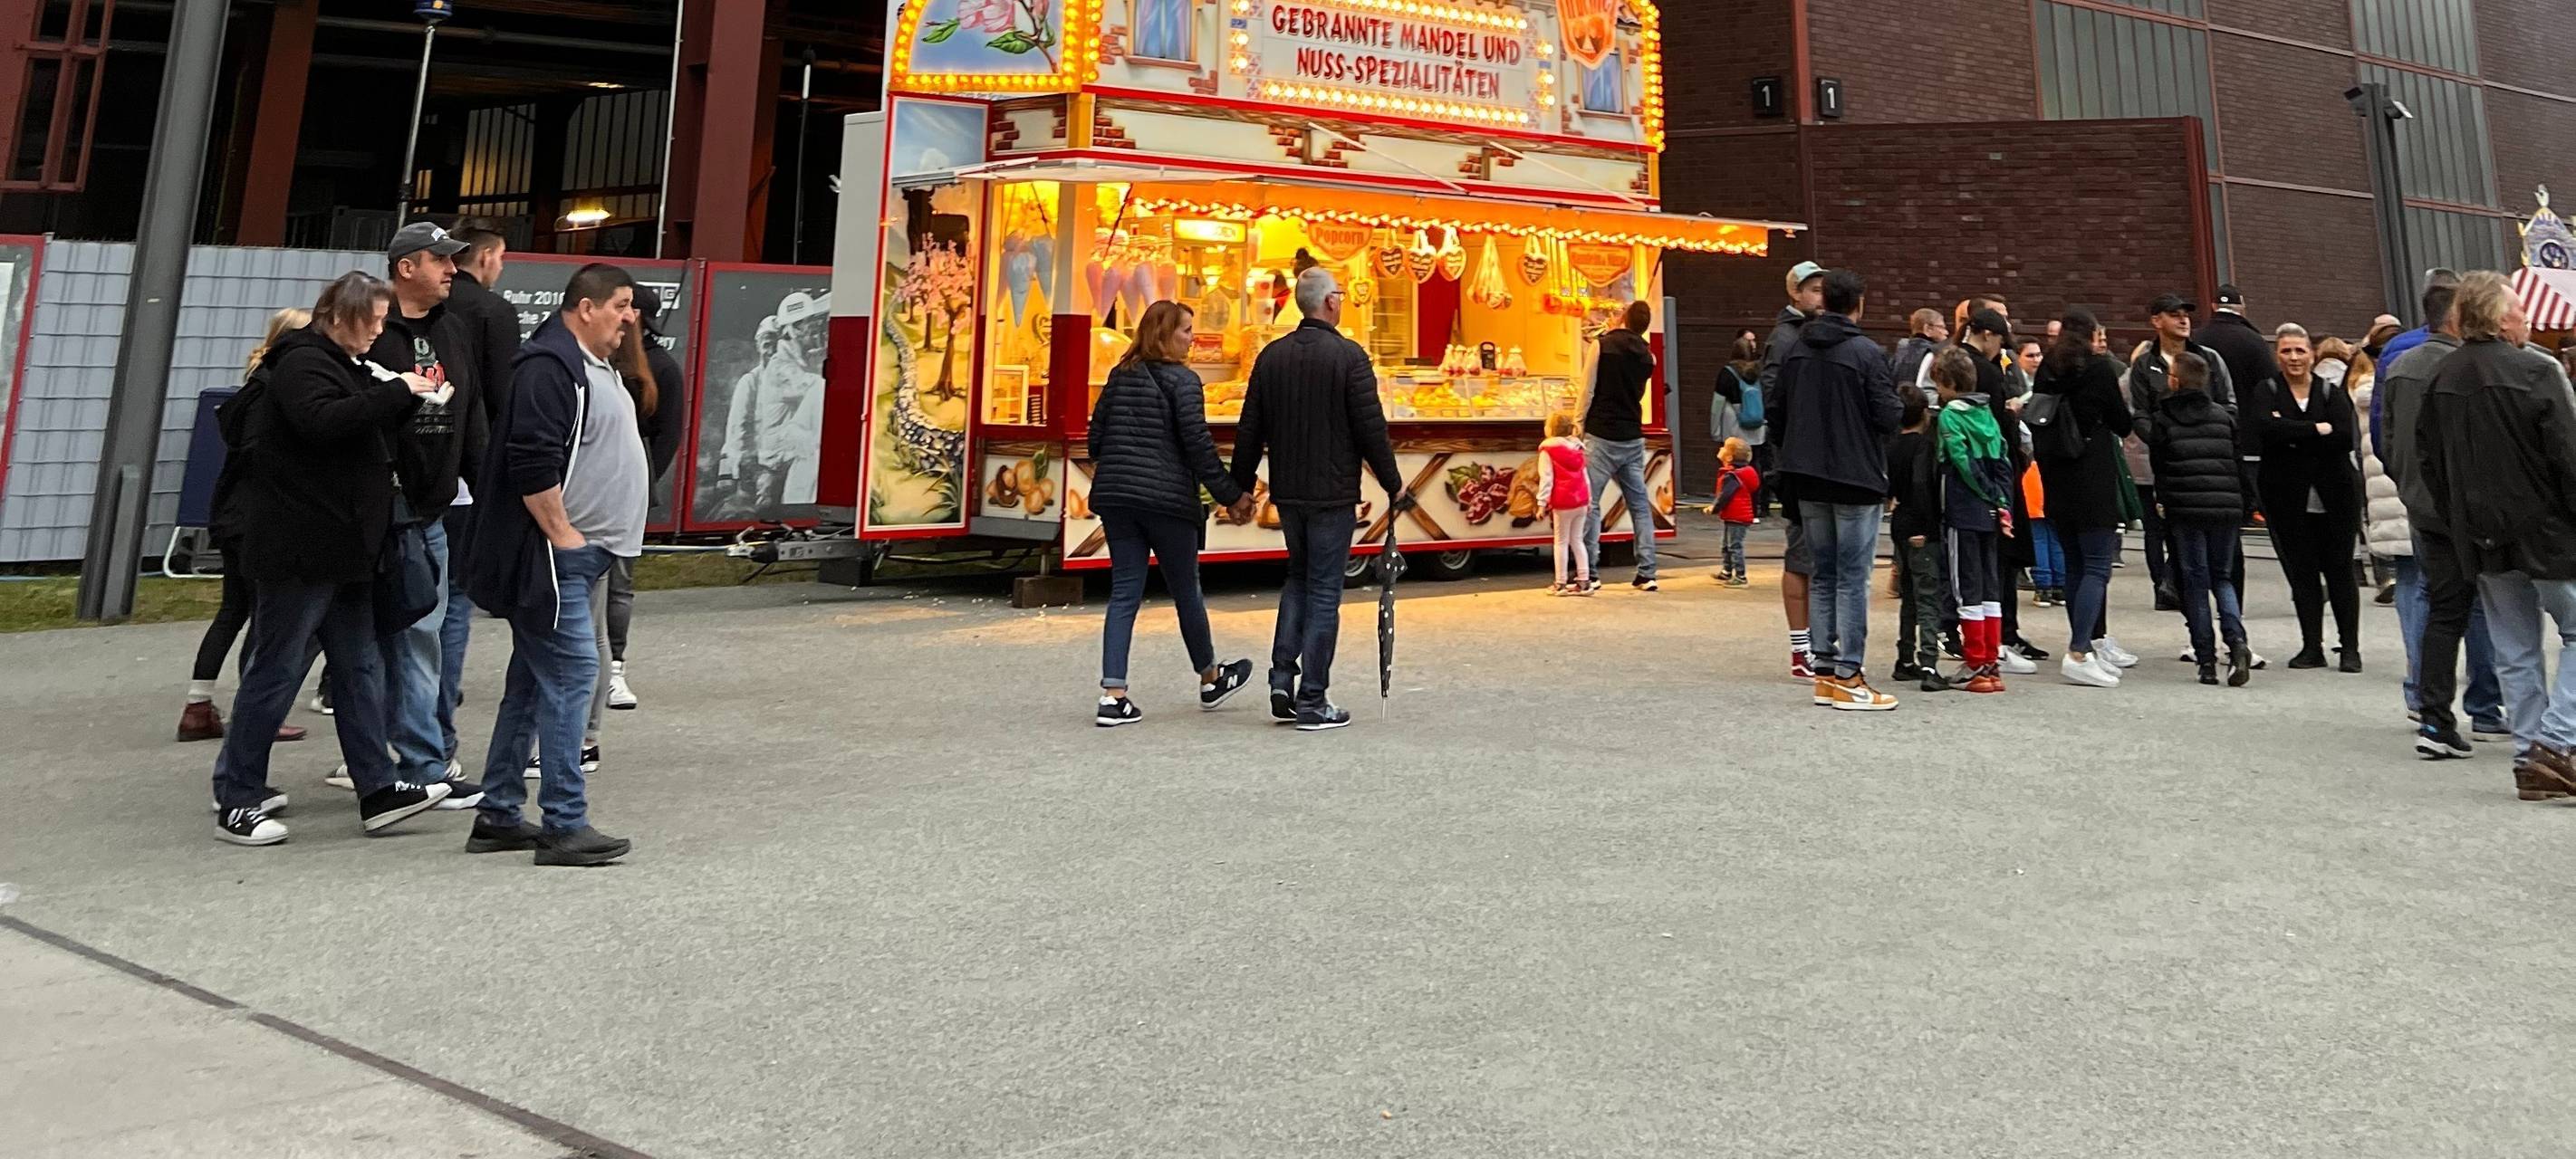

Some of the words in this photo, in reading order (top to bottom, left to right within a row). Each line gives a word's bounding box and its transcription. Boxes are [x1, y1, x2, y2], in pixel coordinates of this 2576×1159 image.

[1272, 5, 1394, 48] GEBRANNTE
[1399, 23, 1479, 61] MANDEL
[1484, 35, 1522, 66] UND
[1296, 47, 1500, 100] NUSS-SPEZIALITÄTEN
[1761, 85, 1771, 107] 1
[1827, 87, 1835, 109] 1
[1315, 226, 1364, 245] Popcorn
